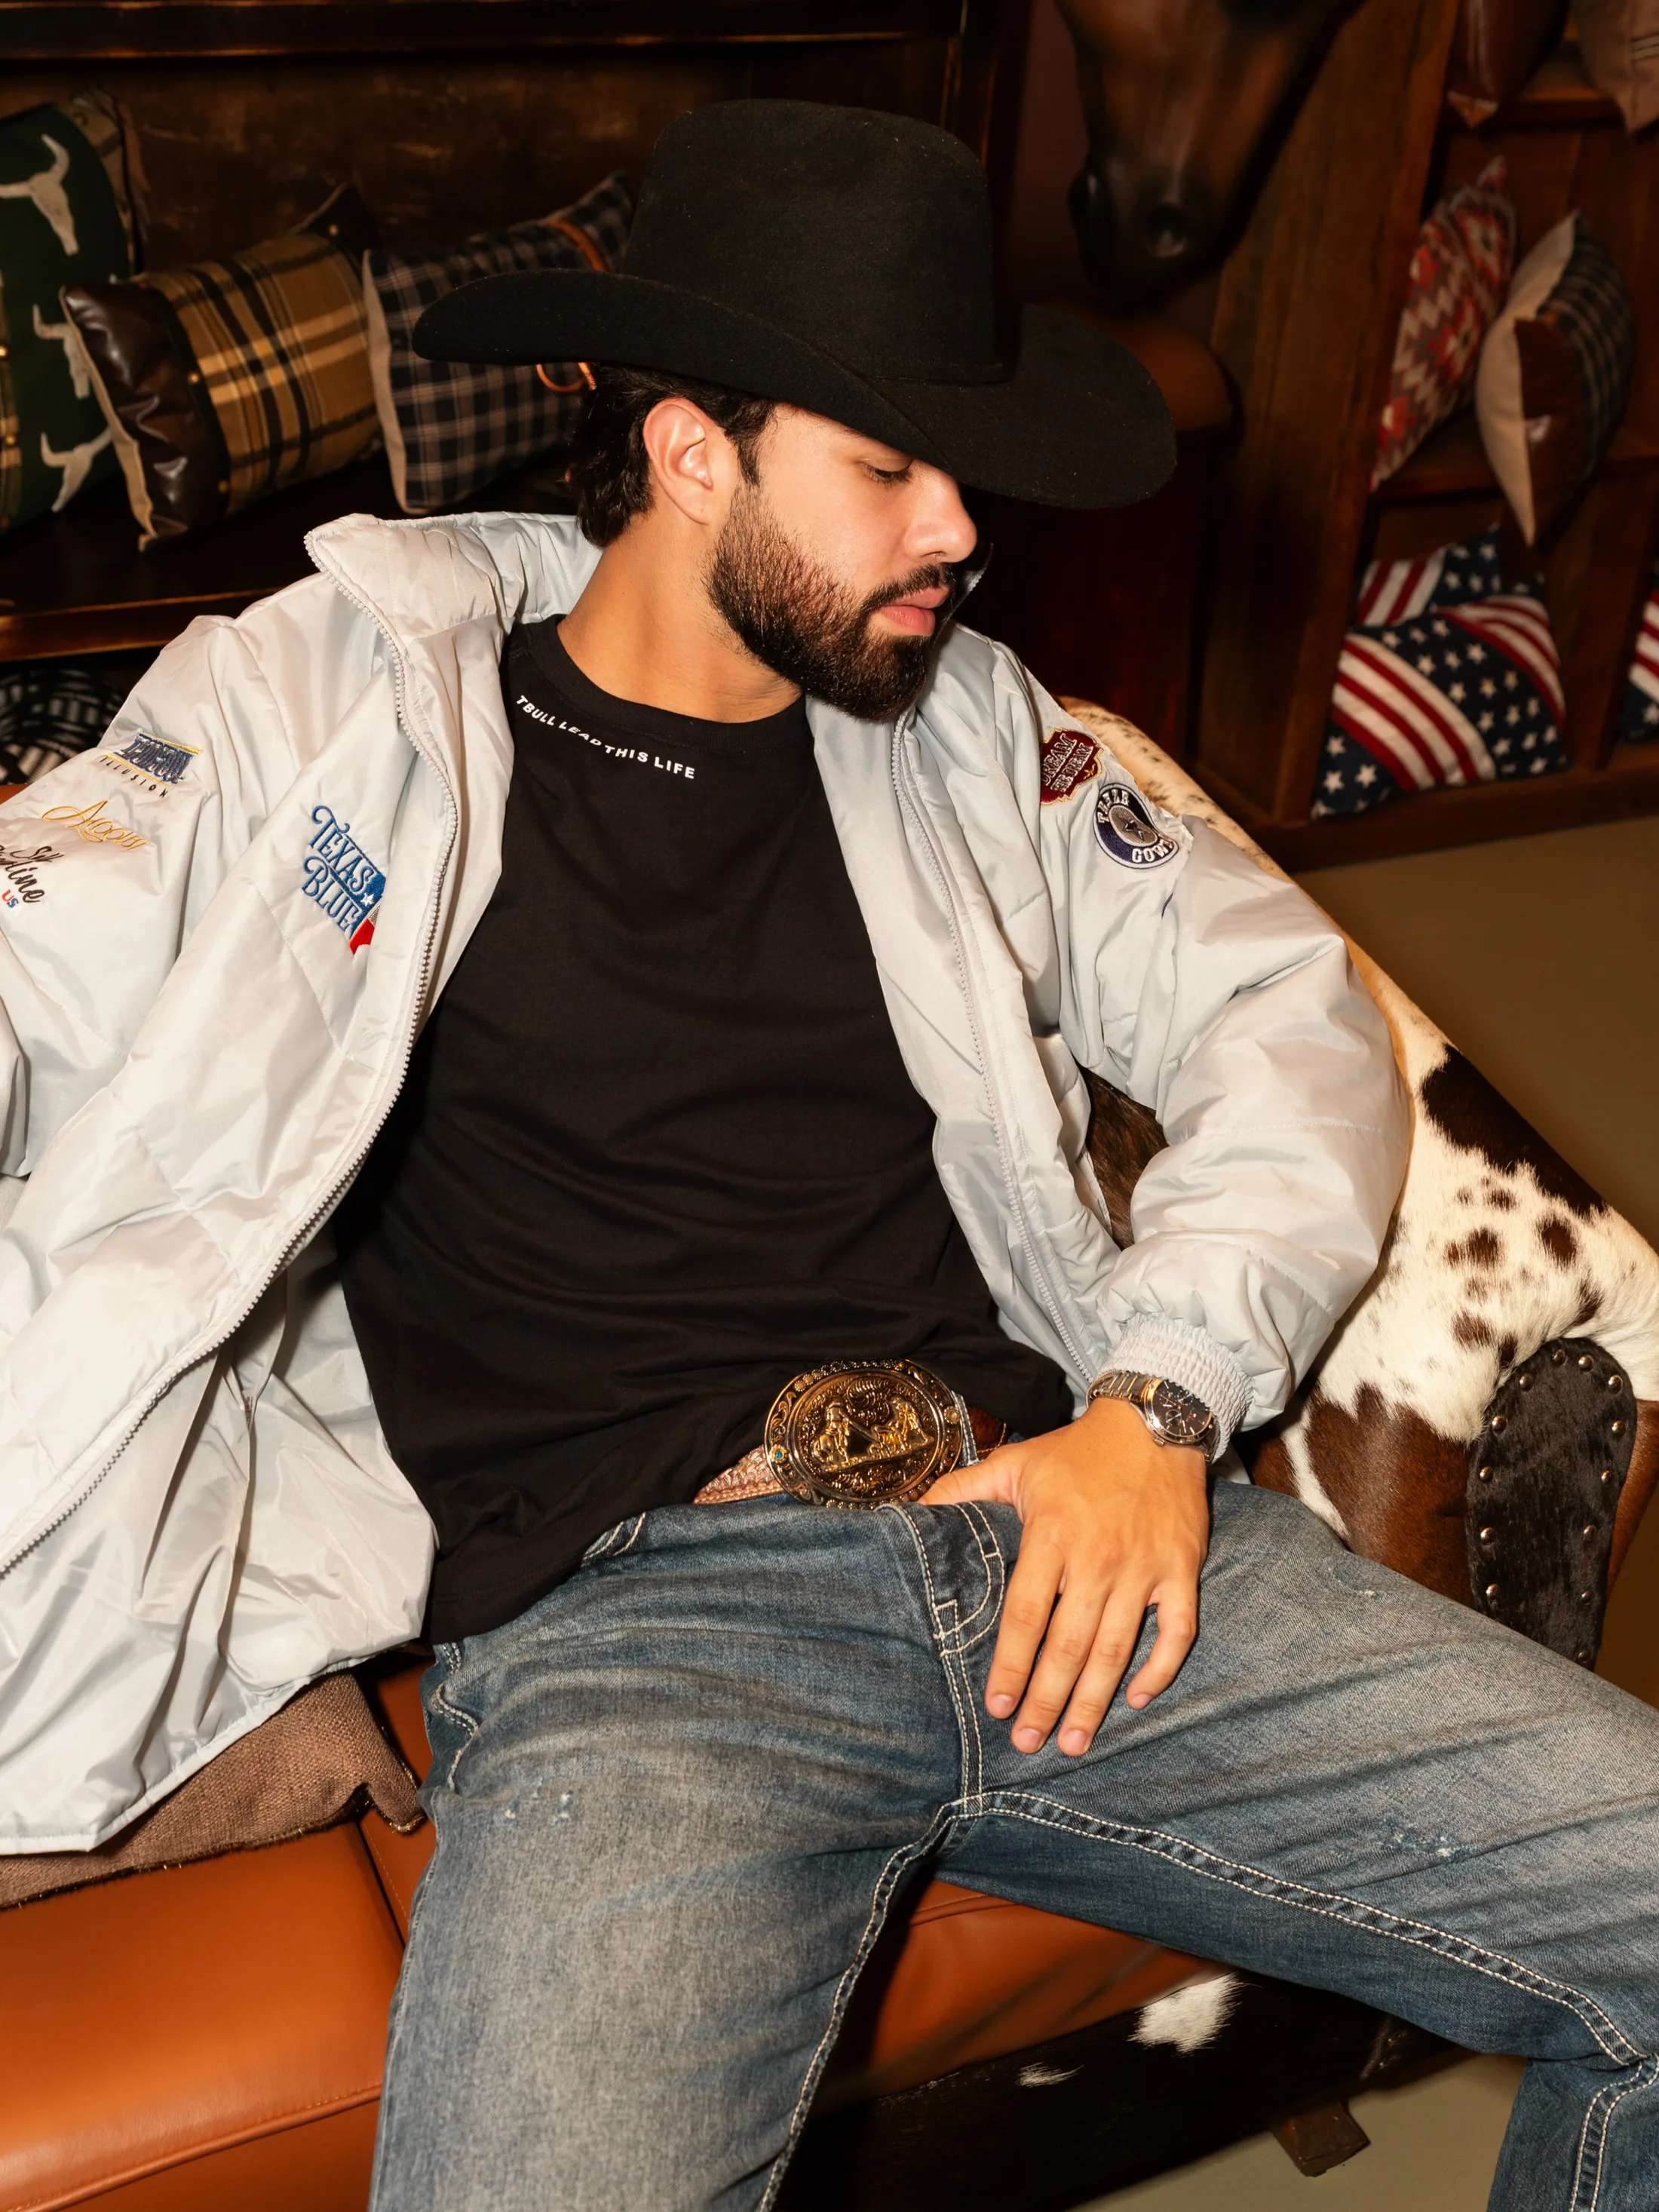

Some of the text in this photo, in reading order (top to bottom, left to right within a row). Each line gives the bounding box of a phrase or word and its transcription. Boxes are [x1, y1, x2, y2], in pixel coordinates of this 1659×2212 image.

[100, 756, 168, 798] ILLUSION
[516, 695, 695, 779] TBULL LEAD THIS LIFE
[308, 805, 377, 893] TEXAS
[302, 855, 362, 932] BLUE
